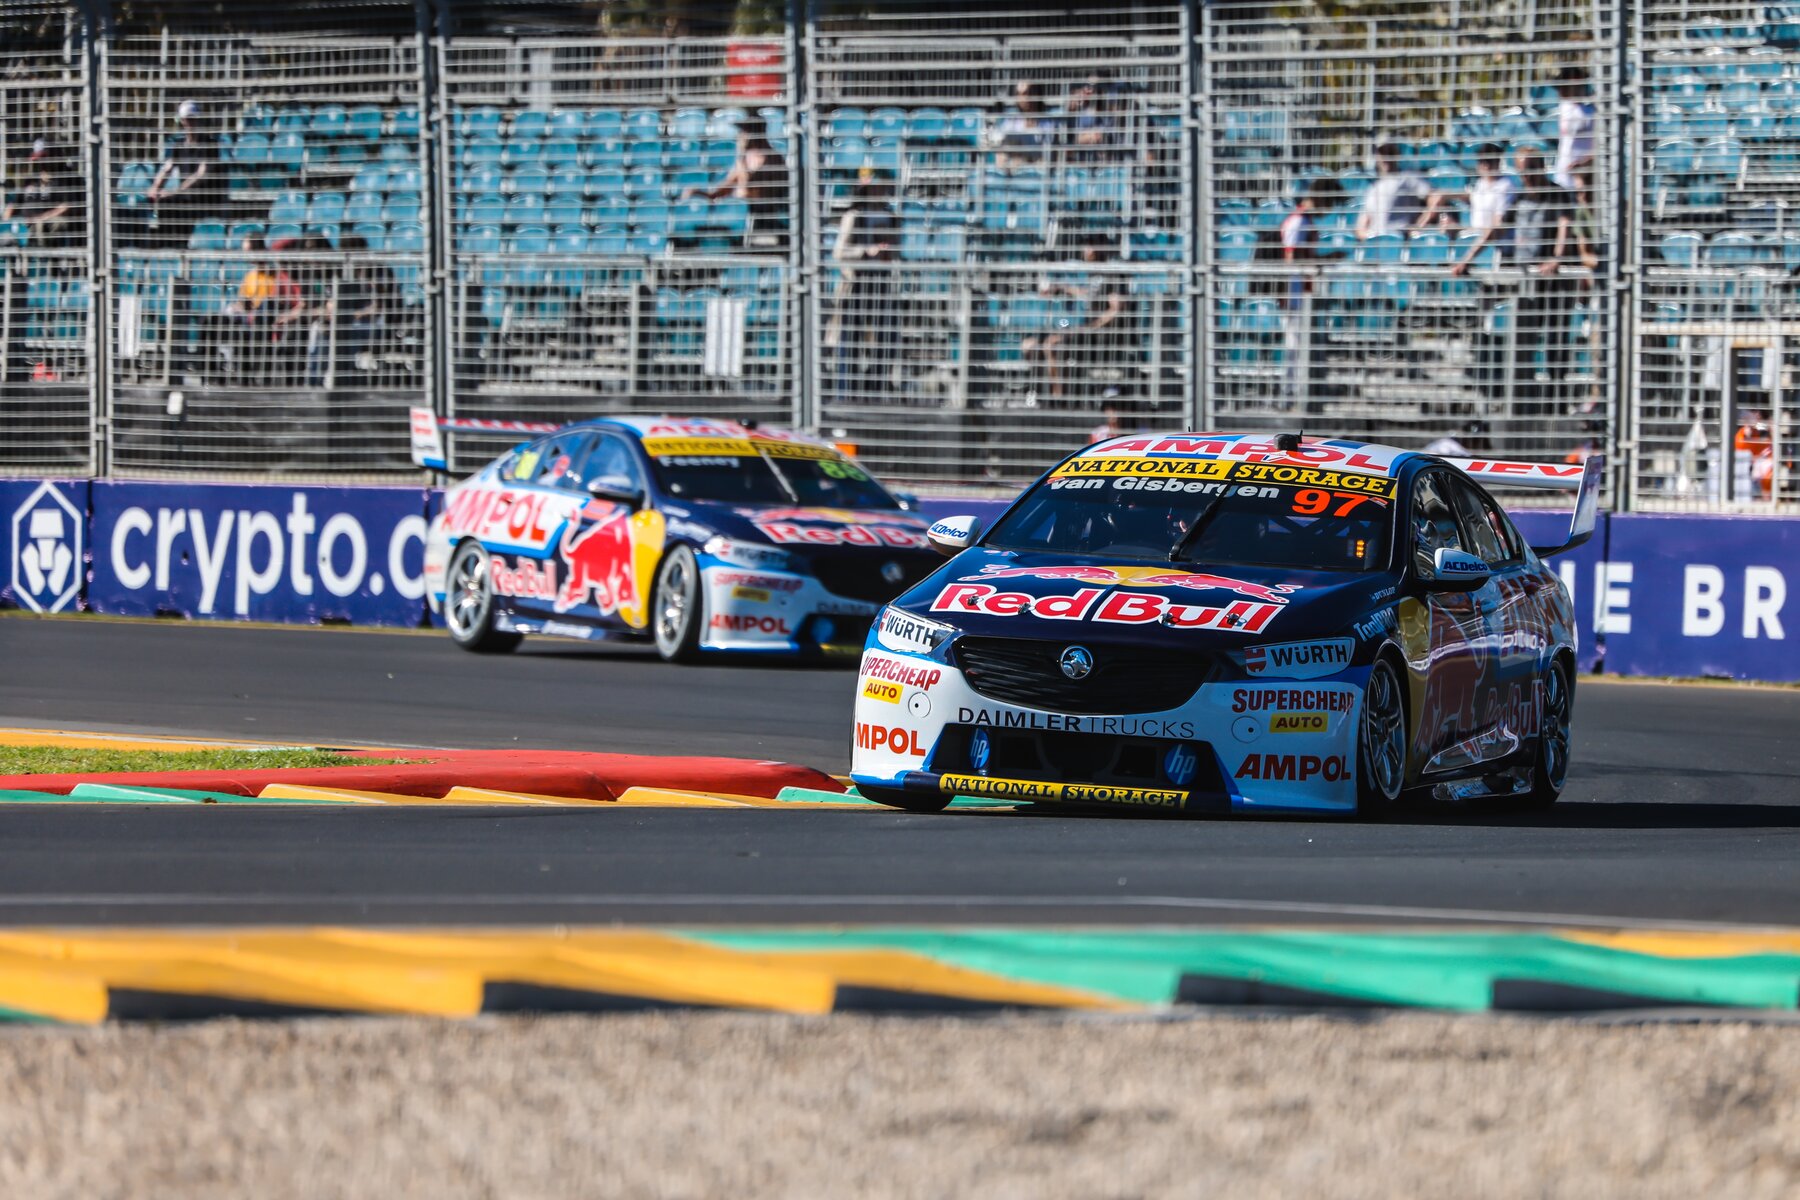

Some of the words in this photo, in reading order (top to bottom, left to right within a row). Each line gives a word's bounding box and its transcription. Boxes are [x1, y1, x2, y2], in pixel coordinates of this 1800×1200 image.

[1093, 438, 1389, 472] AMPOL
[1050, 476, 1103, 492] van
[1111, 477, 1281, 500] Gisbergen
[1061, 457, 1222, 476] NATIONAL
[1233, 464, 1389, 493] STORAGE
[1291, 489, 1367, 517] 97
[1443, 561, 1488, 571] ACDelco
[929, 583, 1107, 622] Red
[1091, 591, 1287, 635] Bull
[709, 614, 791, 635] AMPOL
[885, 613, 937, 648] WÜRTH
[1272, 644, 1348, 667] WÜRTH
[866, 683, 898, 698] AUTO
[1232, 689, 1354, 713] SUPERCHEAP
[959, 707, 1081, 731] DAIMLER
[1087, 717, 1195, 739] TRUCKS
[1276, 717, 1323, 728] AUTO
[970, 728, 987, 770] hp
[1168, 744, 1197, 785] hp
[1235, 754, 1351, 781] AMPOL
[945, 777, 1055, 798] NATIONAL
[1066, 786, 1178, 808] STORAGE
